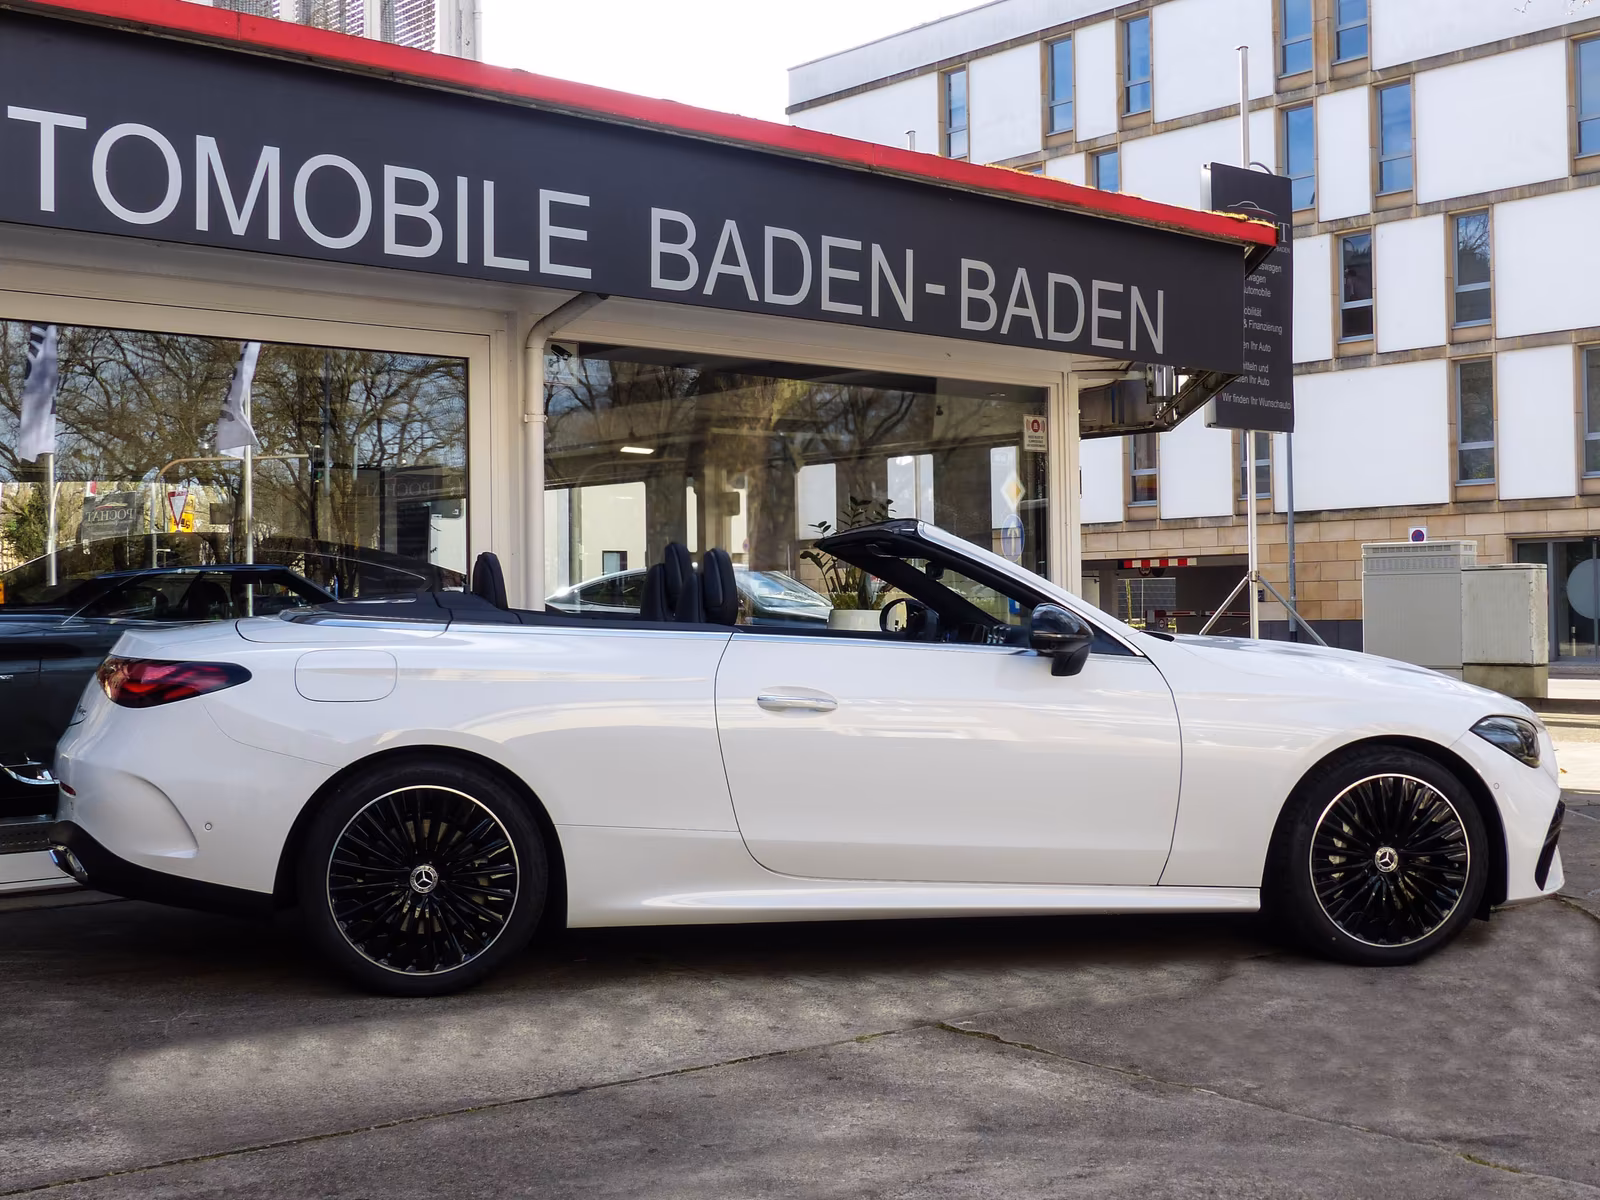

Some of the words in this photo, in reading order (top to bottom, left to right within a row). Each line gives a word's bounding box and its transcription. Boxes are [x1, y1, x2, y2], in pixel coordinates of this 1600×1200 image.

[7, 105, 592, 279] TOMOBILE
[650, 206, 1166, 355] BADEN-BADEN
[1247, 274, 1267, 285] wagen
[1249, 319, 1283, 336] Finanzierung
[1250, 341, 1258, 350] Ihr
[1258, 342, 1272, 352] Auto
[1258, 364, 1269, 373] und
[1249, 375, 1257, 384] Ihr
[1257, 376, 1270, 386] Auto
[1222, 392, 1232, 402] Wir
[1232, 393, 1250, 404] finden
[1250, 395, 1259, 405] Ihr
[1259, 397, 1292, 410] Wunschauto
